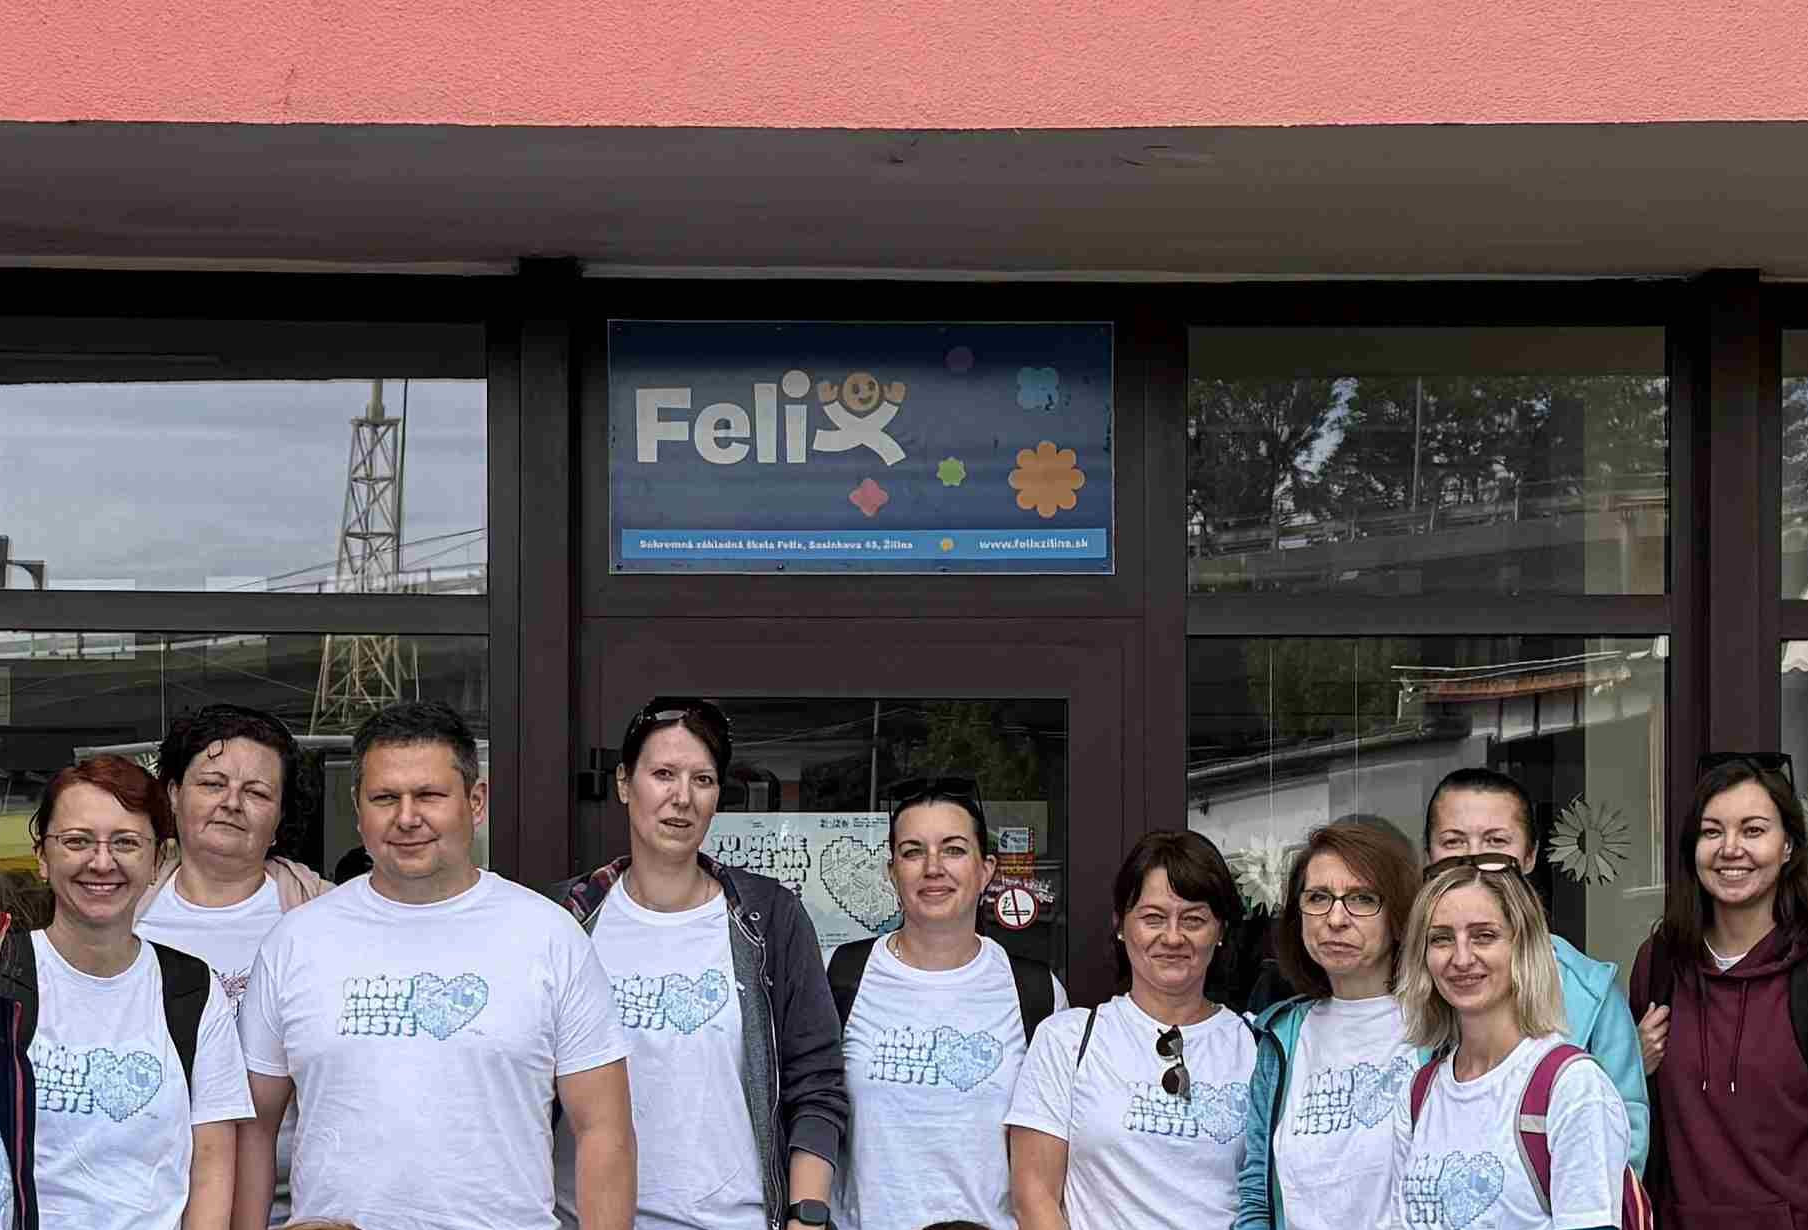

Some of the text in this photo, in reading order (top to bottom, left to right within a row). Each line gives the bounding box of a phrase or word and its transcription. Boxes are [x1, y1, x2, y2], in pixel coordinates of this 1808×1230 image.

[635, 369, 908, 466] Felix
[711, 831, 808, 853] TU MÁME
[776, 850, 811, 868] NA
[343, 975, 416, 1000] MÁM
[336, 1015, 417, 1037] MESTE
[874, 1025, 937, 1051] MÁM
[866, 1062, 939, 1085] MESTE
[1122, 1112, 1198, 1138] MESTE
